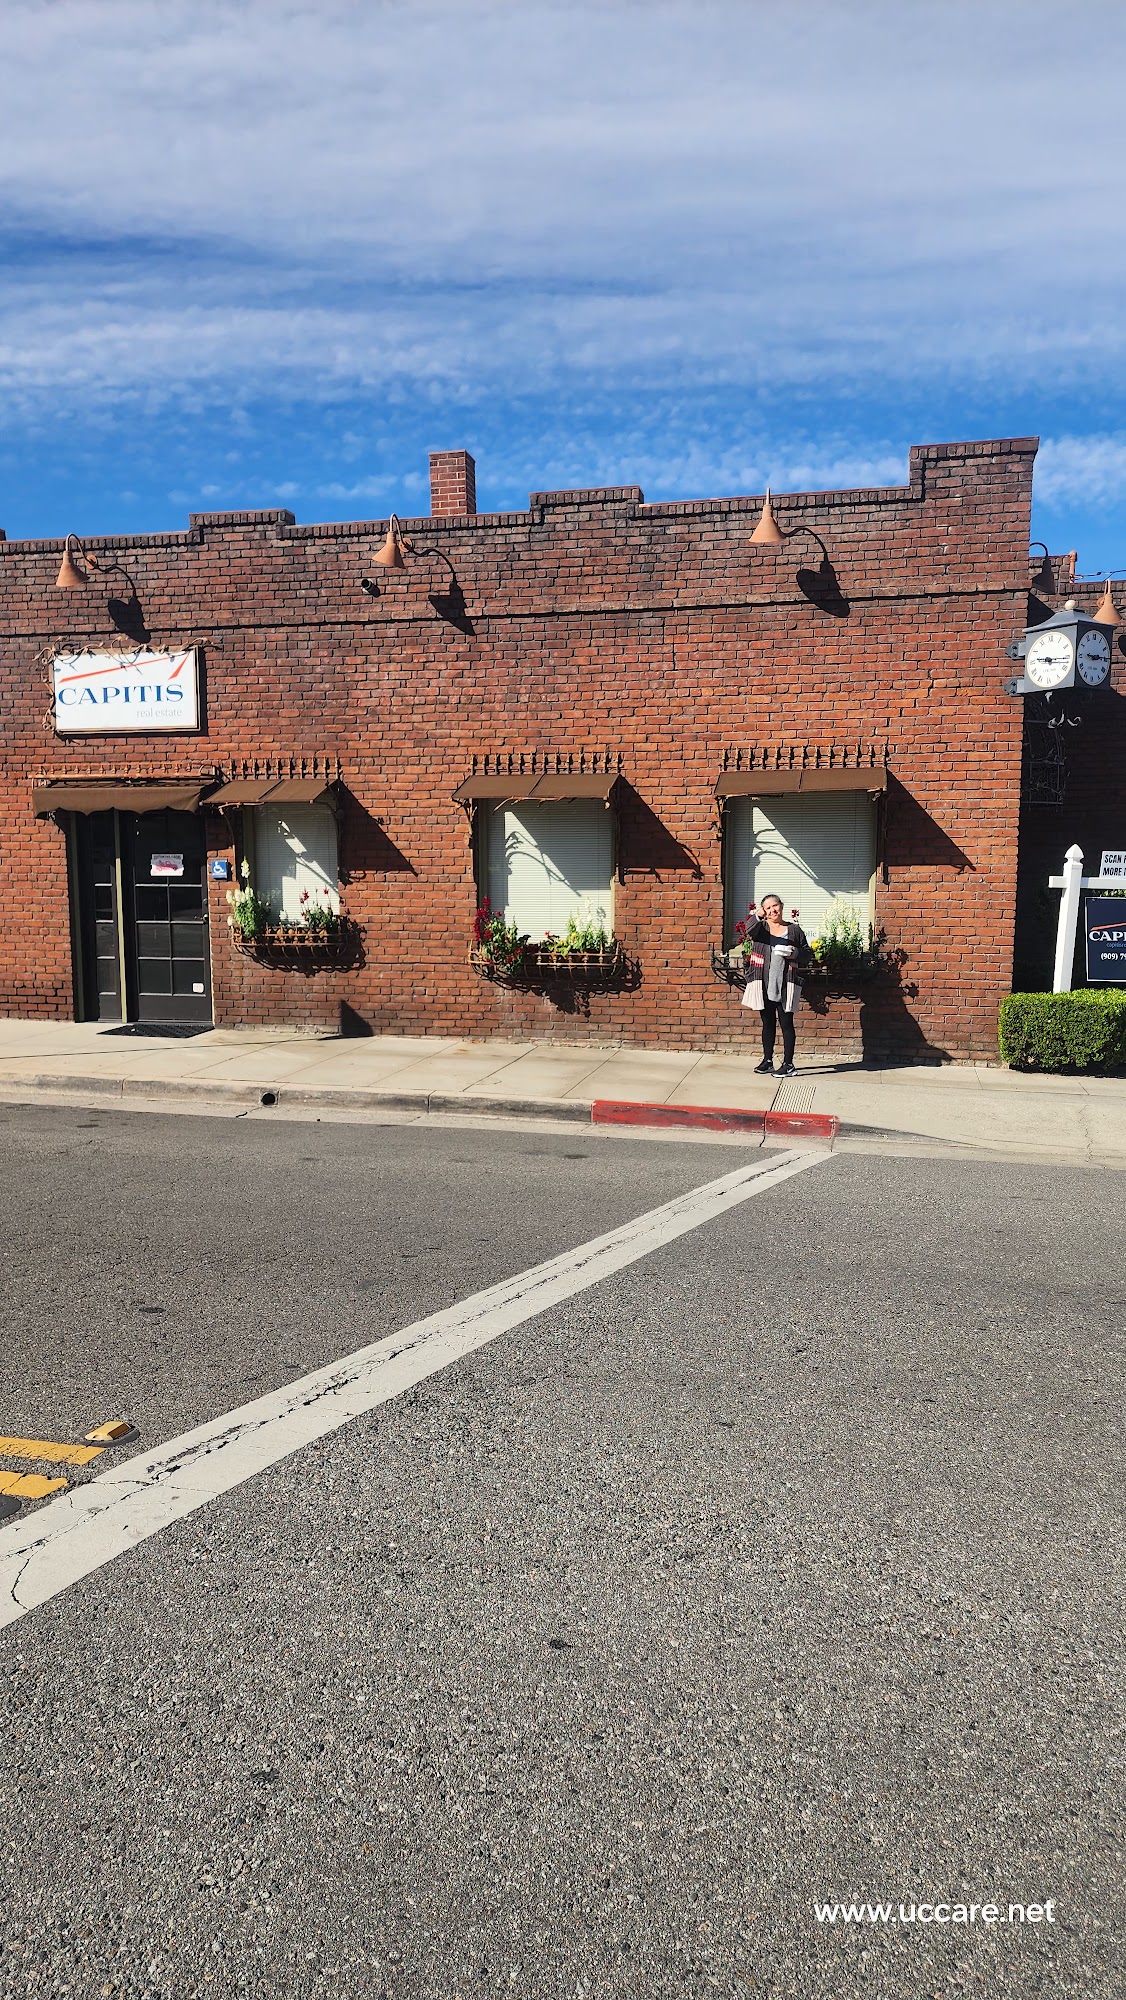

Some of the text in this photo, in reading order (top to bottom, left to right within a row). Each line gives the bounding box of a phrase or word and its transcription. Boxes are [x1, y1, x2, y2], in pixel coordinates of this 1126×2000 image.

[58, 684, 184, 706] CAPITIS
[136, 707, 182, 718] real estate
[1104, 854, 1122, 864] SCAN
[1102, 867, 1122, 876] MORE
[1100, 952, 1119, 961] (909)
